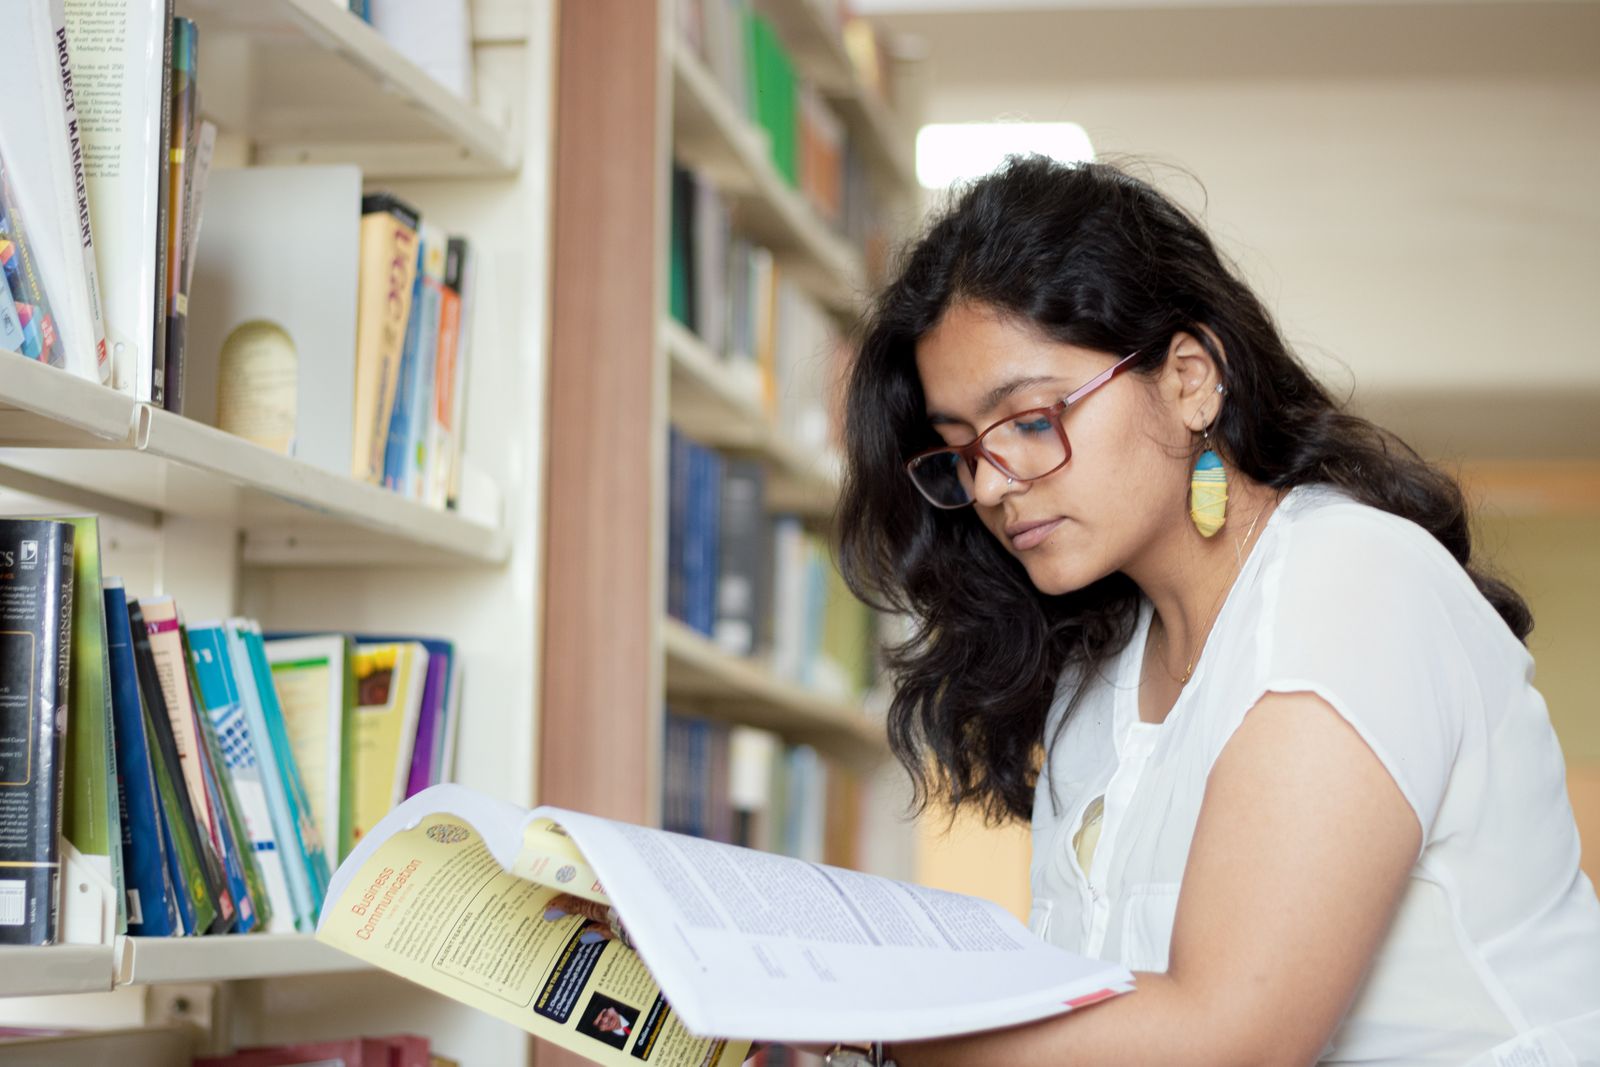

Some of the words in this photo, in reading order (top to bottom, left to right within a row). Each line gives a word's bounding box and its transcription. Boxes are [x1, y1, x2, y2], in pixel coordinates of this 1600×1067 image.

[56, 26, 76, 112] PROJECT
[68, 118, 93, 249] MANAGEMENT
[58, 583, 68, 686] ECONOMICS
[352, 867, 394, 917] Business
[356, 859, 422, 940] Communication
[450, 910, 473, 941] FEATURES
